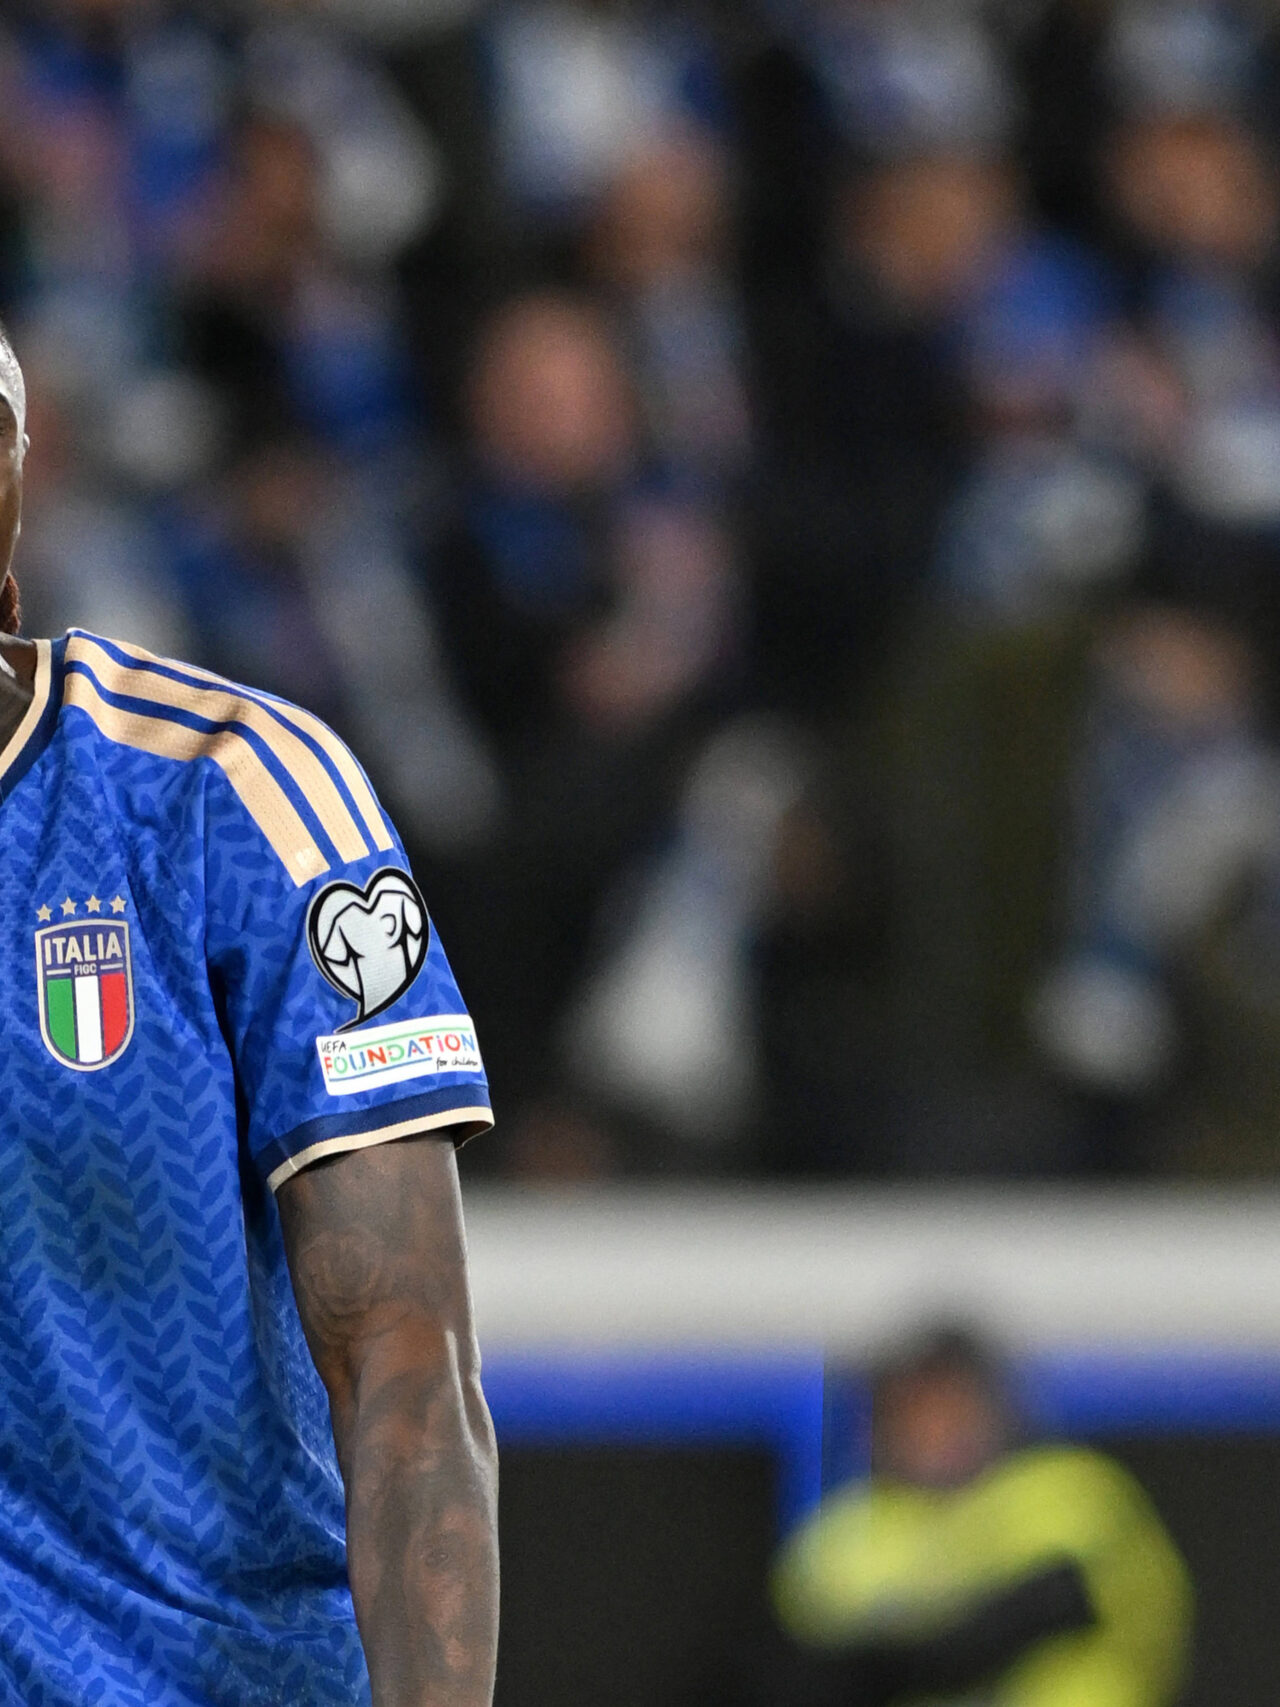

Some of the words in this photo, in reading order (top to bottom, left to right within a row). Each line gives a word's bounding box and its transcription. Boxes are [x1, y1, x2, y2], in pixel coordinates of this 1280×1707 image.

[44, 932, 122, 966] ITALIA
[74, 963, 97, 976] FIGC
[321, 1040, 347, 1053] UEFA
[436, 1057, 447, 1071] for
